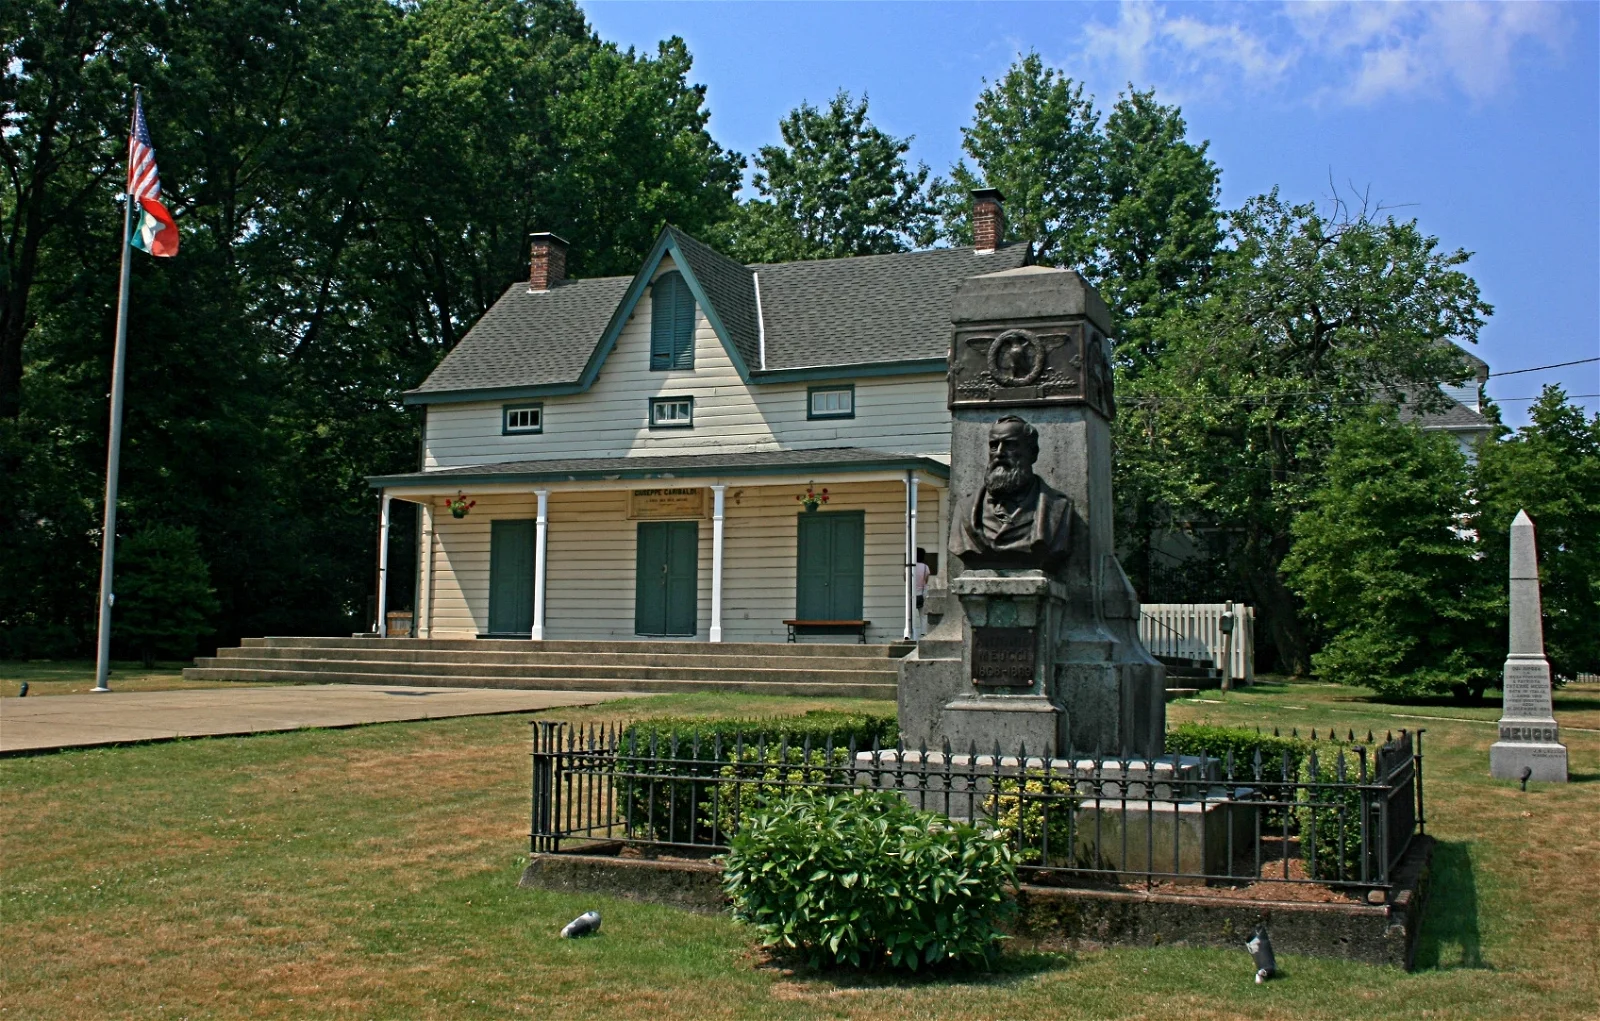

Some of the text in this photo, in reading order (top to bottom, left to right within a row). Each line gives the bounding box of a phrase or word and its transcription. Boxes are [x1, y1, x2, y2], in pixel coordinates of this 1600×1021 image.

[664, 488, 697, 496] GARIBALDI
[978, 649, 1029, 662] MEUCCI
[1500, 727, 1559, 742] MEUCCI
